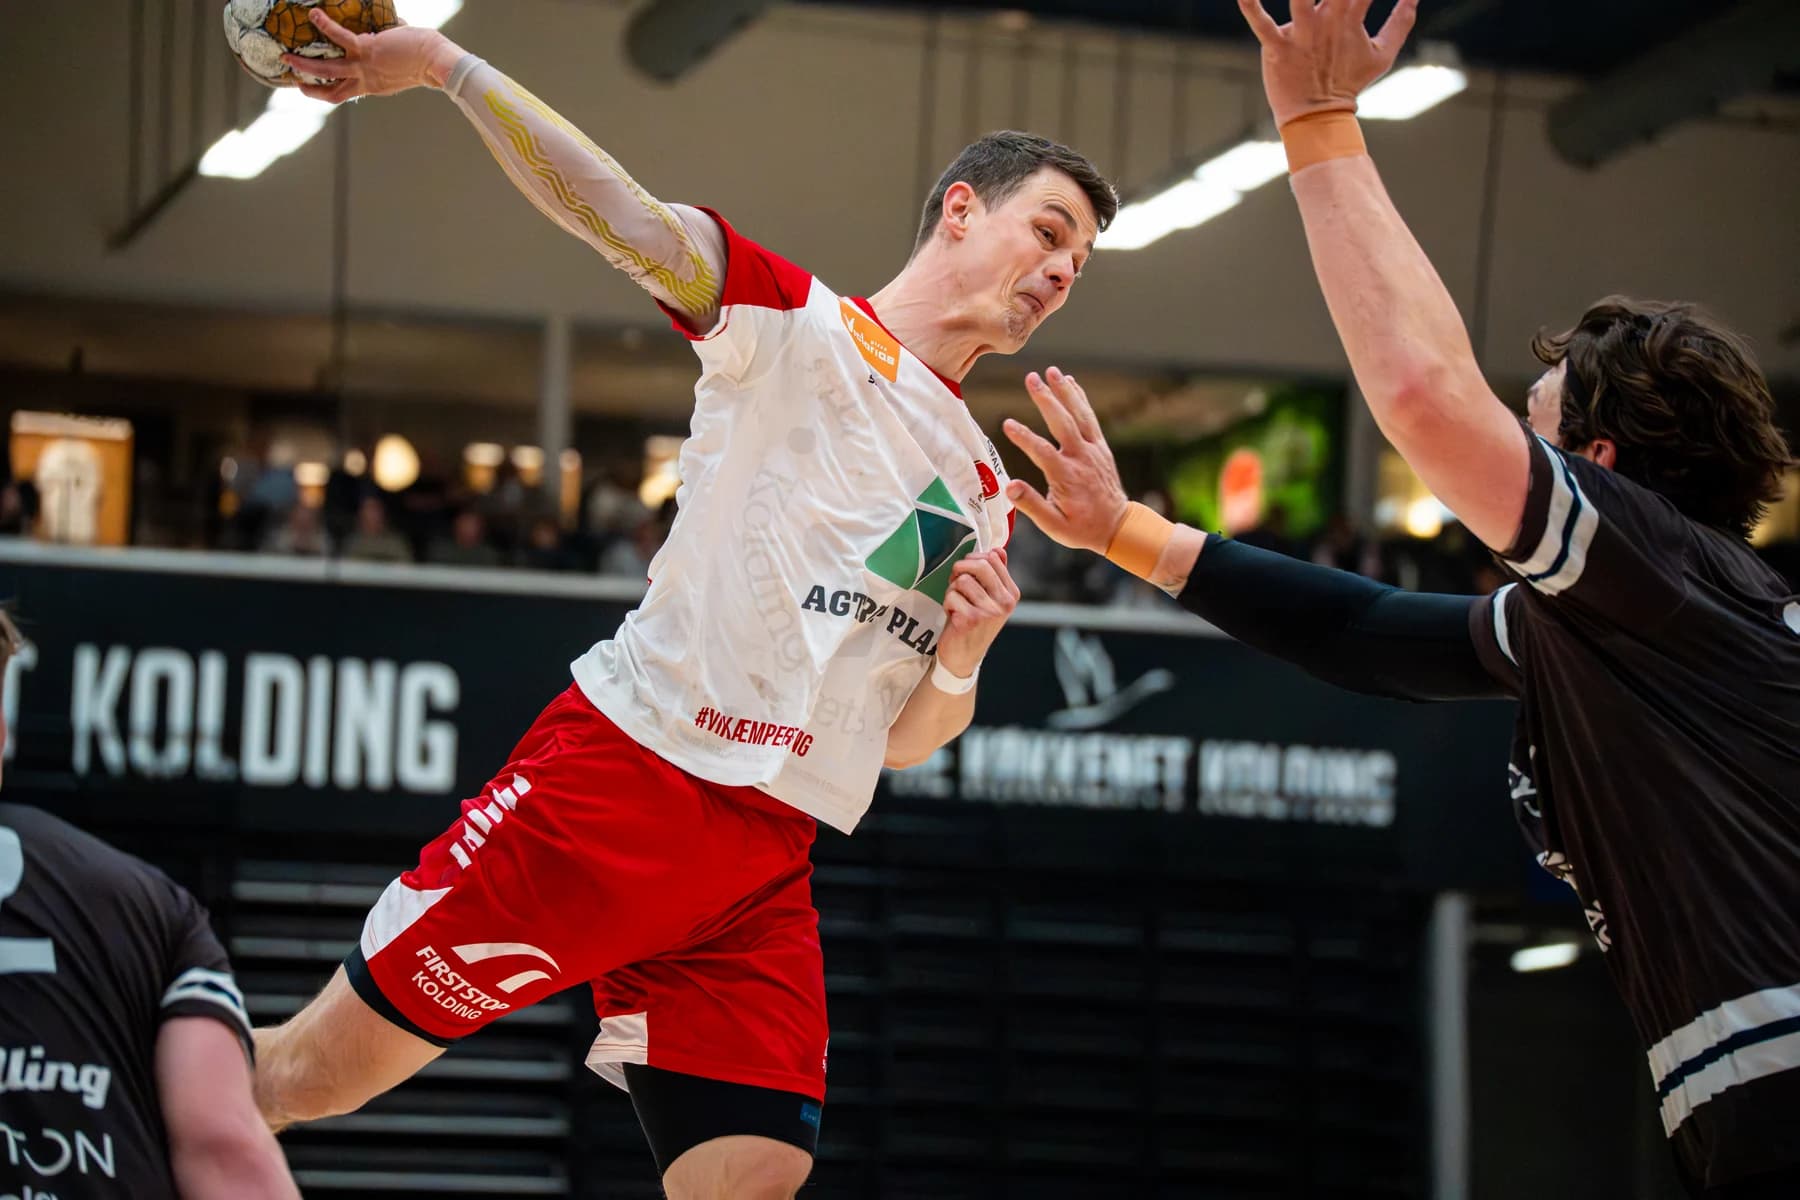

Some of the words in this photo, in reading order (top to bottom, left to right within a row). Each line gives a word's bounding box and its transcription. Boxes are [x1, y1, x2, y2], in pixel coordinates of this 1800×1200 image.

[71, 643, 460, 794] KOLDING
[411, 970, 482, 1020] KOLDING
[415, 945, 510, 1011] FIRSTSTOP
